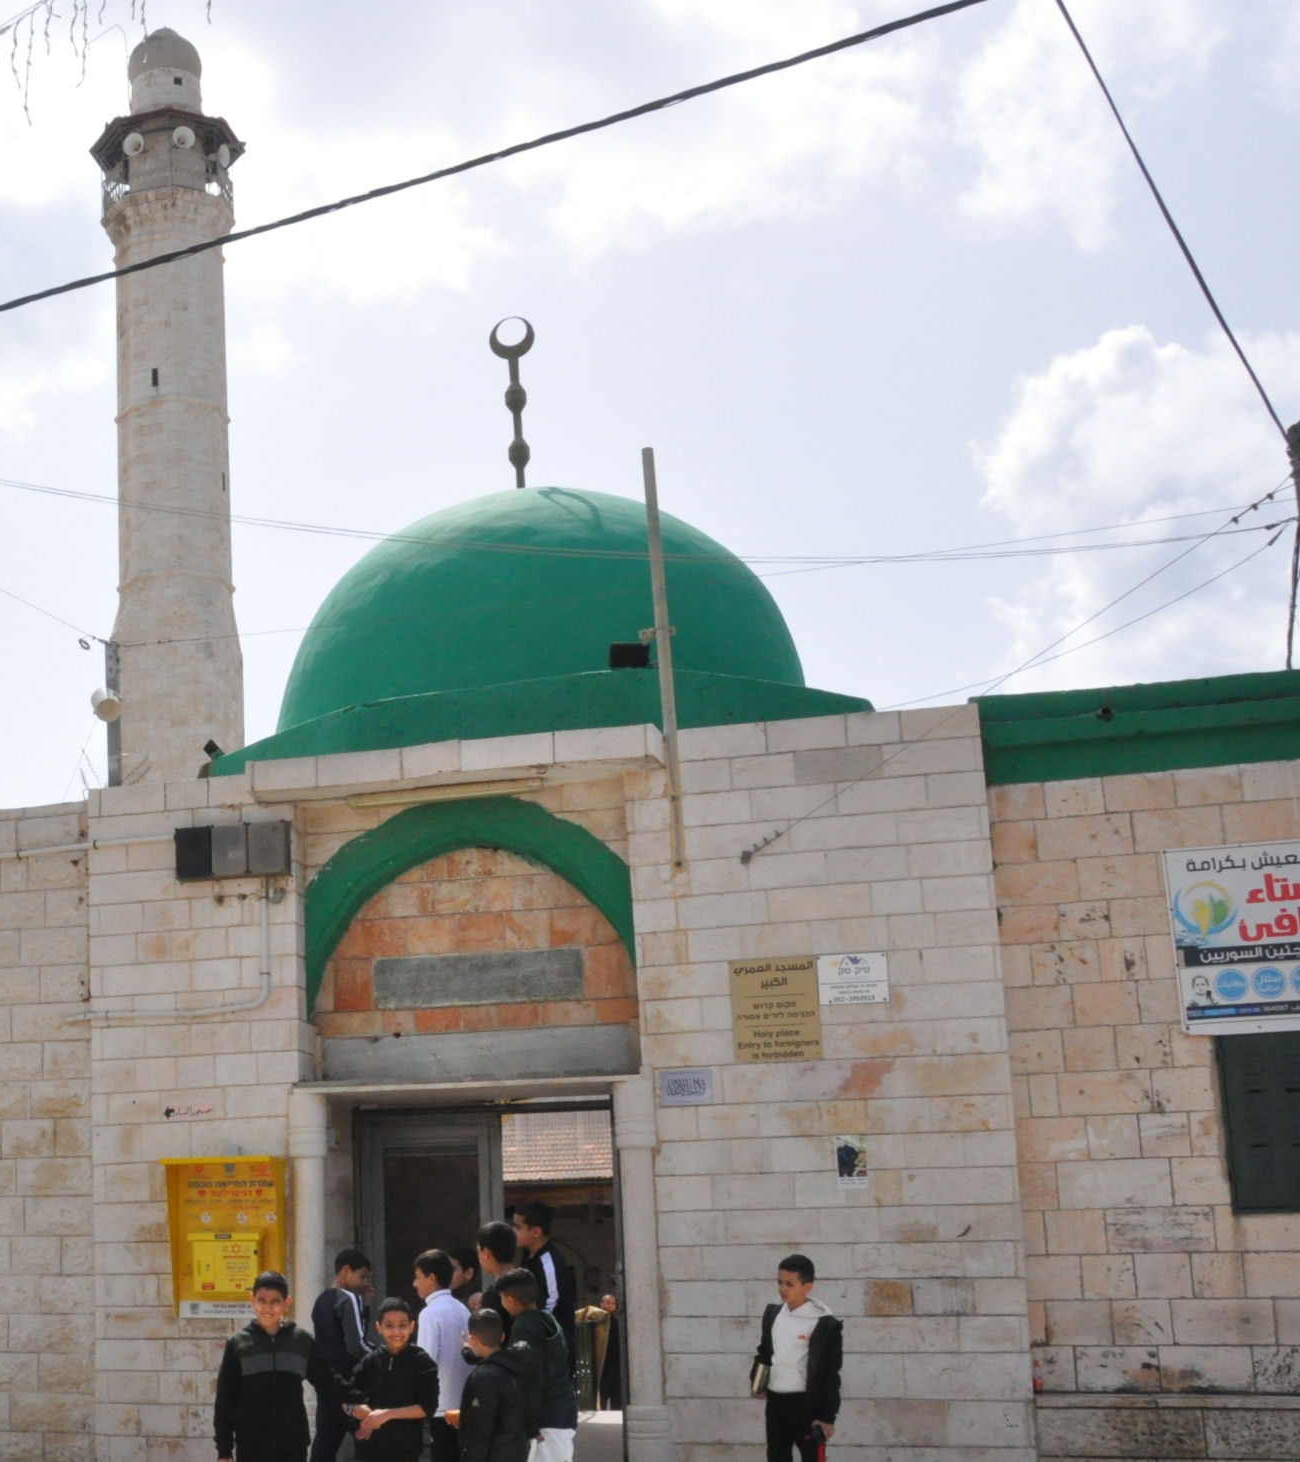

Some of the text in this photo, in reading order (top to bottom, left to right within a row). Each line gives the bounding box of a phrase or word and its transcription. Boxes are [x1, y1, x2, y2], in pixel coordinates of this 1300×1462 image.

[1186, 851, 1300, 873] عيش بكرامة
[1200, 946, 1263, 964] السوريين
[733, 960, 814, 977] المسجد العمري
[760, 976, 788, 990] الكبير
[753, 1001, 797, 1010] מקום קדוש
[736, 1010, 815, 1021] הכניסה לזרים אסורה
[753, 1029, 800, 1039] Holy place
[737, 1041, 762, 1050] Entry
[774, 1039, 820, 1048] foreigners
[761, 1050, 805, 1059] forbidden
